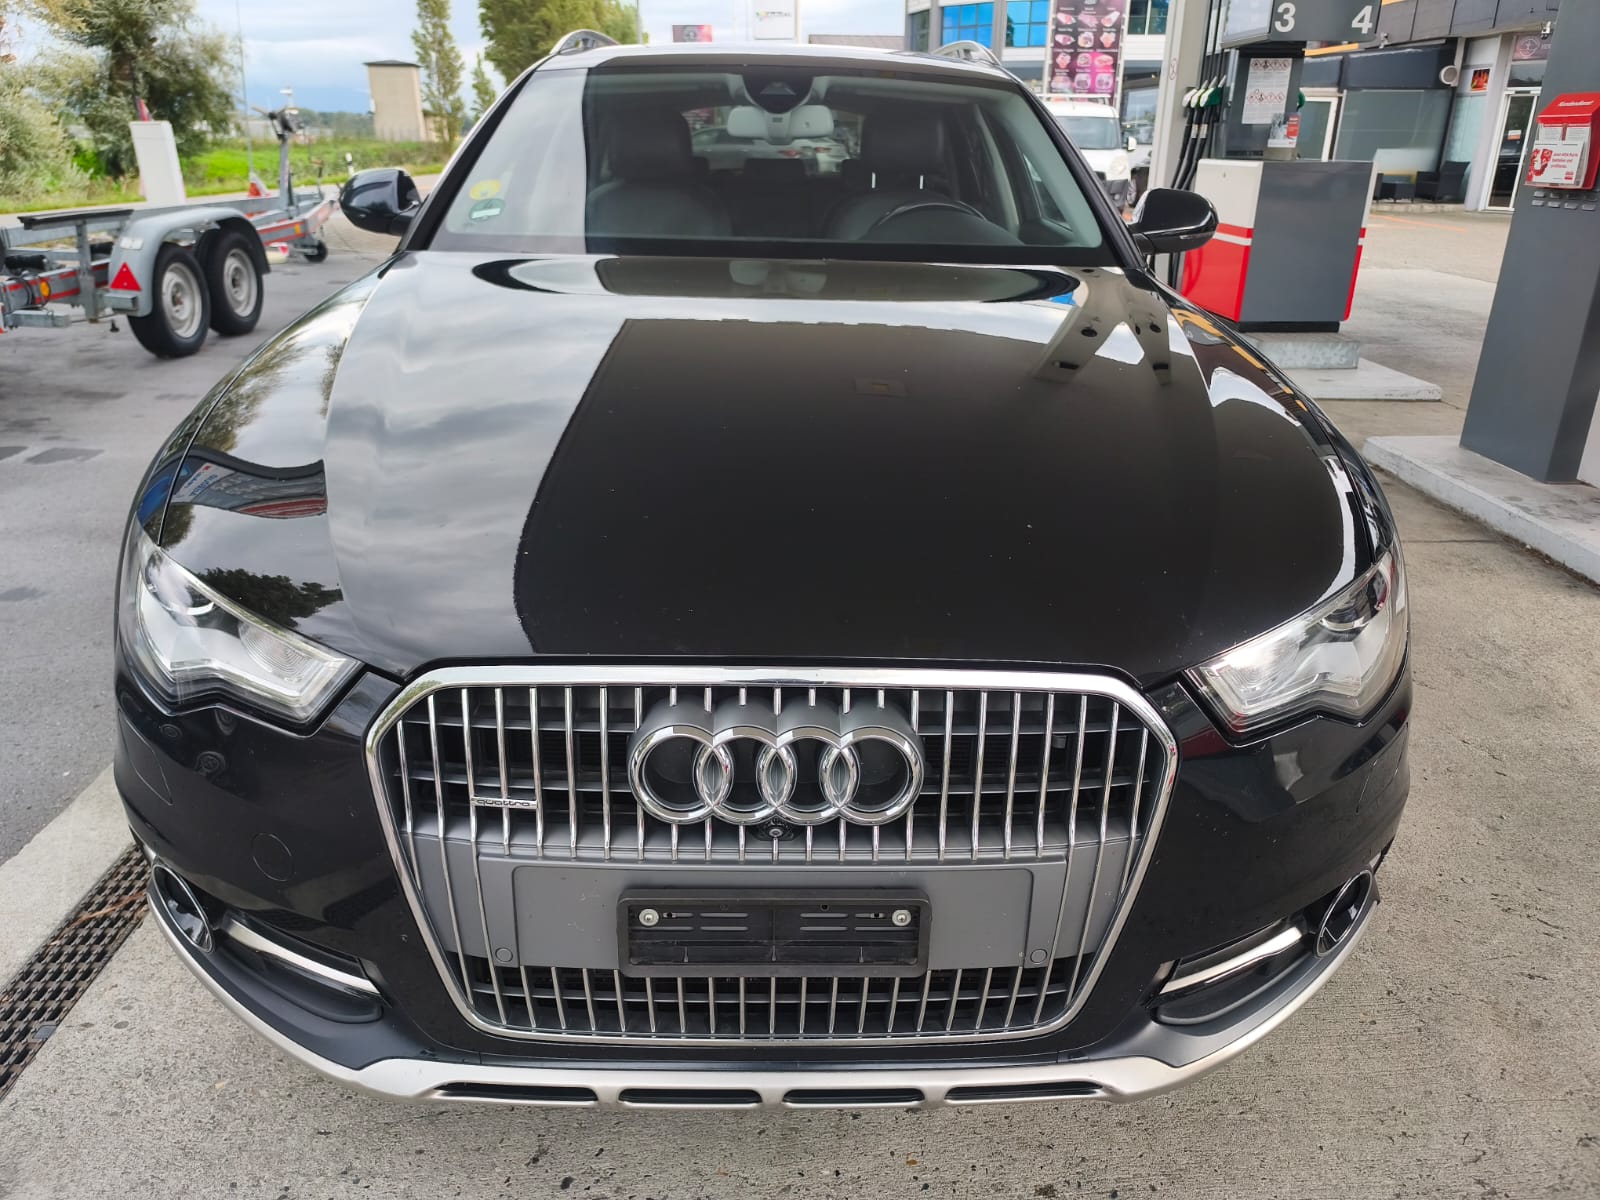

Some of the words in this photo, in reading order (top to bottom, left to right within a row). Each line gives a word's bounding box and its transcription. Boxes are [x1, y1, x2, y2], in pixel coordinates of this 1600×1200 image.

[1275, 2, 1296, 32] 3
[1351, 5, 1373, 34] 4
[476, 799, 531, 807] quattro
